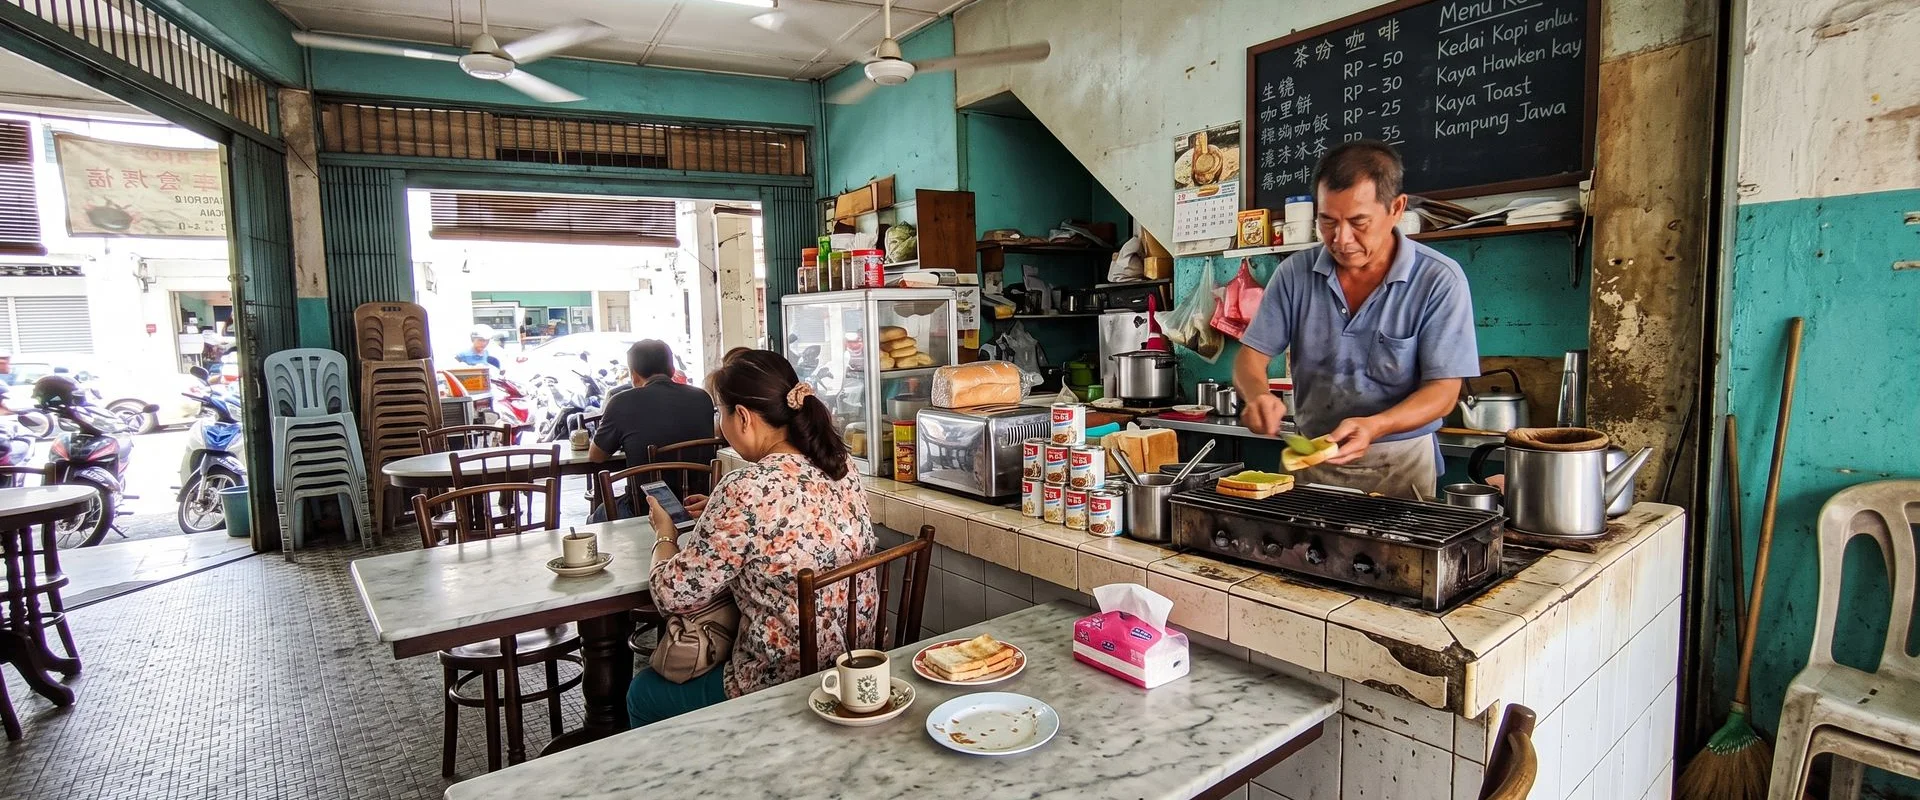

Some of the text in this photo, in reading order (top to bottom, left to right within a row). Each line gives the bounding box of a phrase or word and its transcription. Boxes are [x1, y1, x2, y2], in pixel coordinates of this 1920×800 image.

[1439, 0, 1492, 27] Menu
[1438, 31, 1484, 60] Kedai
[1493, 19, 1528, 46] Kopi
[1344, 60, 1363, 80] RP
[1382, 51, 1403, 69] 50
[1437, 65, 1476, 87] Kaya
[1483, 47, 1546, 74] Hawken
[1344, 84, 1363, 103] RP
[1382, 75, 1402, 94] 30
[1435, 75, 1532, 116] Kaya Toast
[1344, 107, 1363, 126] RP
[1381, 99, 1401, 117] 25
[1435, 101, 1566, 139] Kampung Jawa
[1382, 125, 1401, 142] 35
